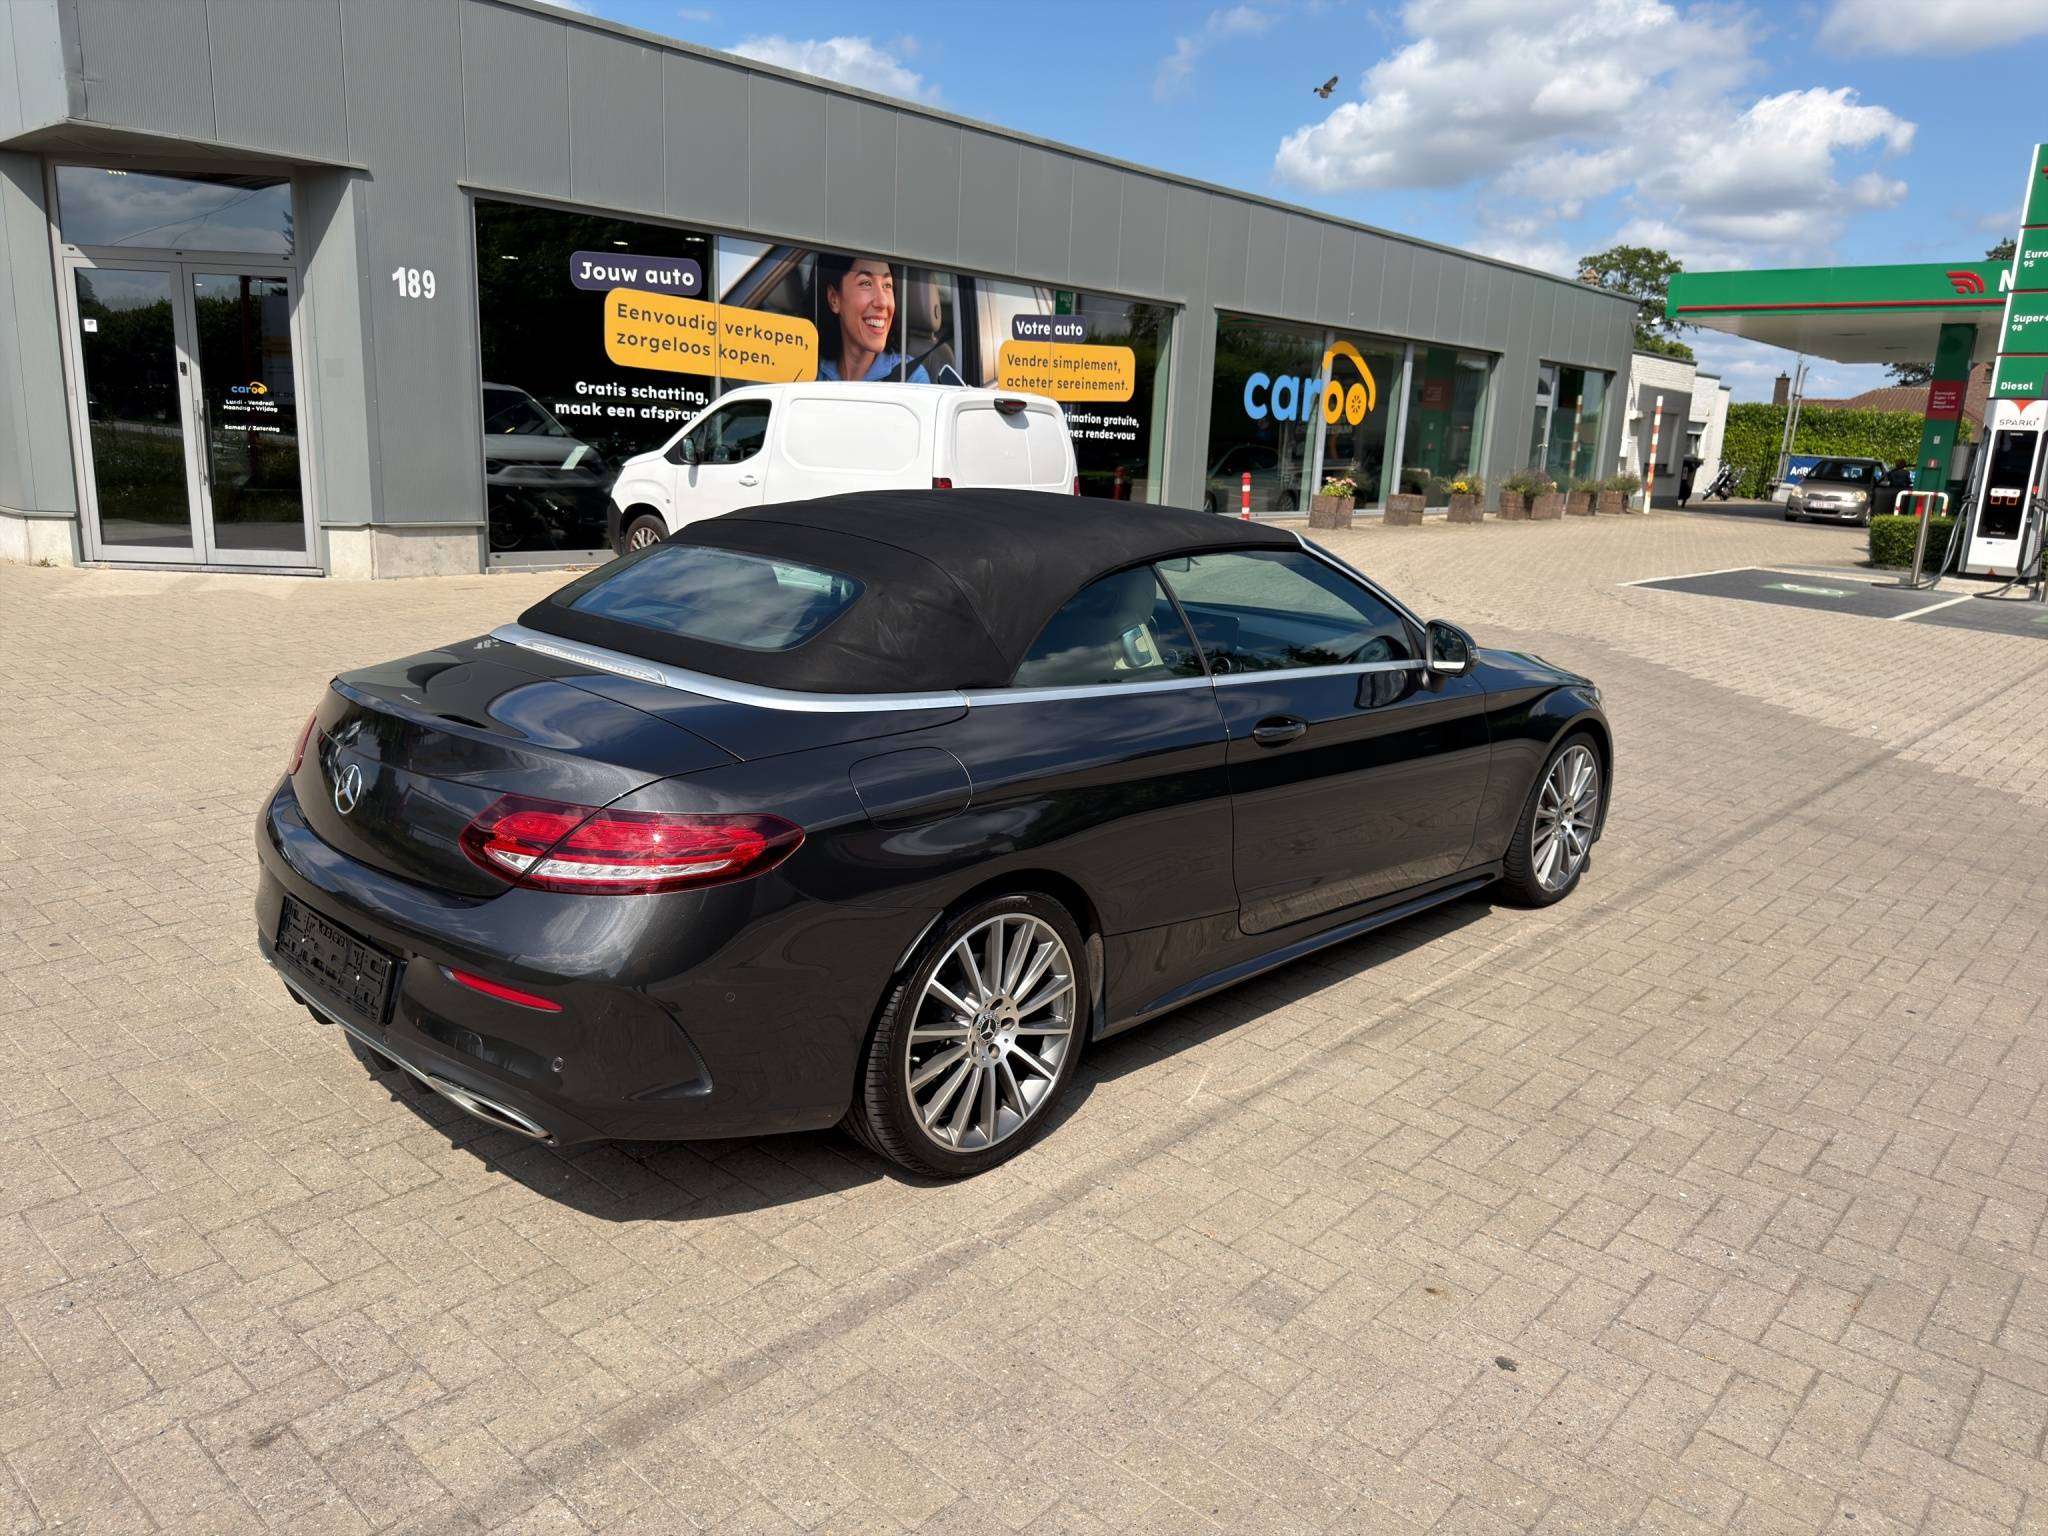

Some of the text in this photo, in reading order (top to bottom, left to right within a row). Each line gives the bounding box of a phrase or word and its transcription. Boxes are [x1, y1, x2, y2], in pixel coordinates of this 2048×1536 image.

[2025, 250, 2048, 258] Euro
[392, 267, 436, 299] 189
[580, 261, 695, 286] Jouw auto
[618, 303, 809, 350] Eenvoudig verkopen,
[1016, 321, 1083, 336] Votre auto
[617, 332, 775, 366] zorgeloos kopen.
[1007, 354, 1121, 373] Vendre simplement,
[575, 381, 709, 405] Gratis schatting,
[1007, 376, 1128, 391] acheter sereinement.
[2001, 382, 2033, 390] Diesel
[555, 402, 704, 422] maak een afspraa
[1065, 412, 1140, 428] timation gratuite,
[1069, 429, 1136, 440] nez rendez-vous
